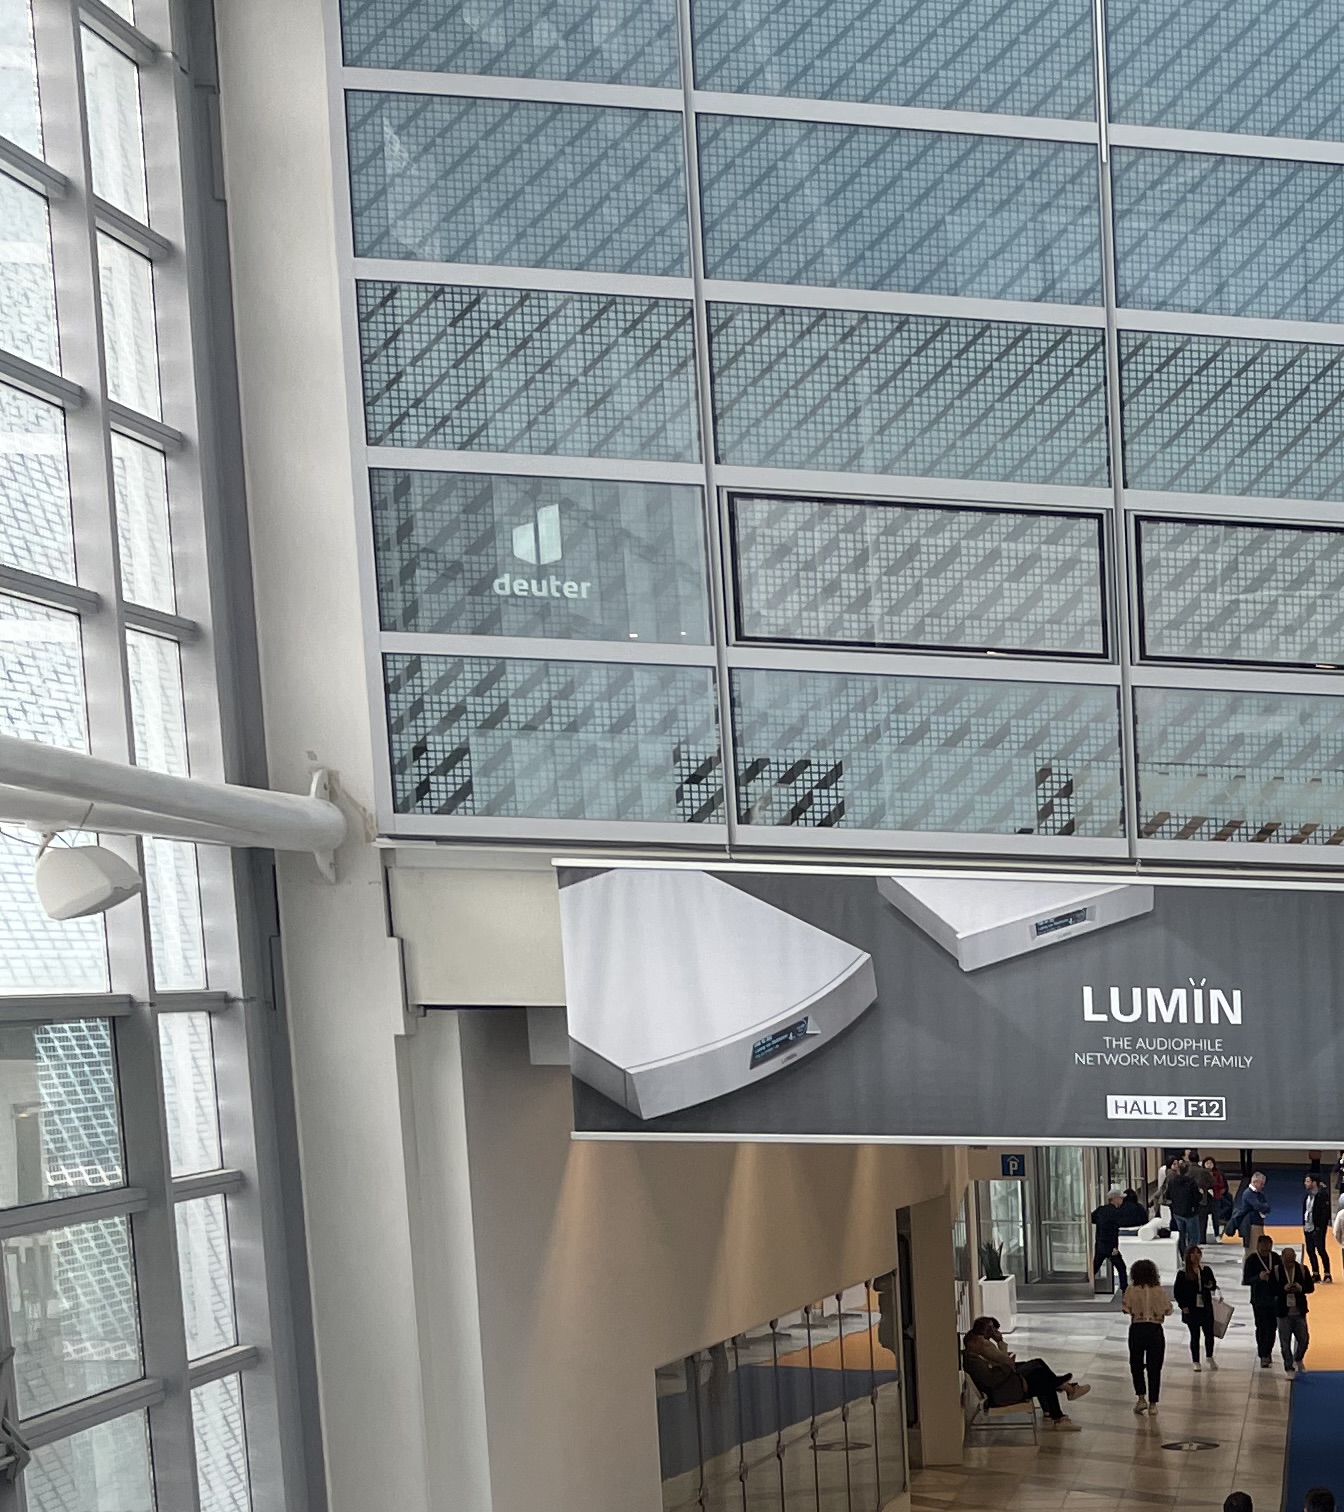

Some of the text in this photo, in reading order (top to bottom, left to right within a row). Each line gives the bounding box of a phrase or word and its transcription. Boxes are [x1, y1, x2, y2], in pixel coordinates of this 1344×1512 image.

[493, 573, 592, 599] deuter
[1103, 1036, 1223, 1052] THE AUDIOPHILE
[1074, 1052, 1253, 1069] NETWORK MUSIC FAMILY
[1114, 1100, 1221, 1117] HALL 2 F12
